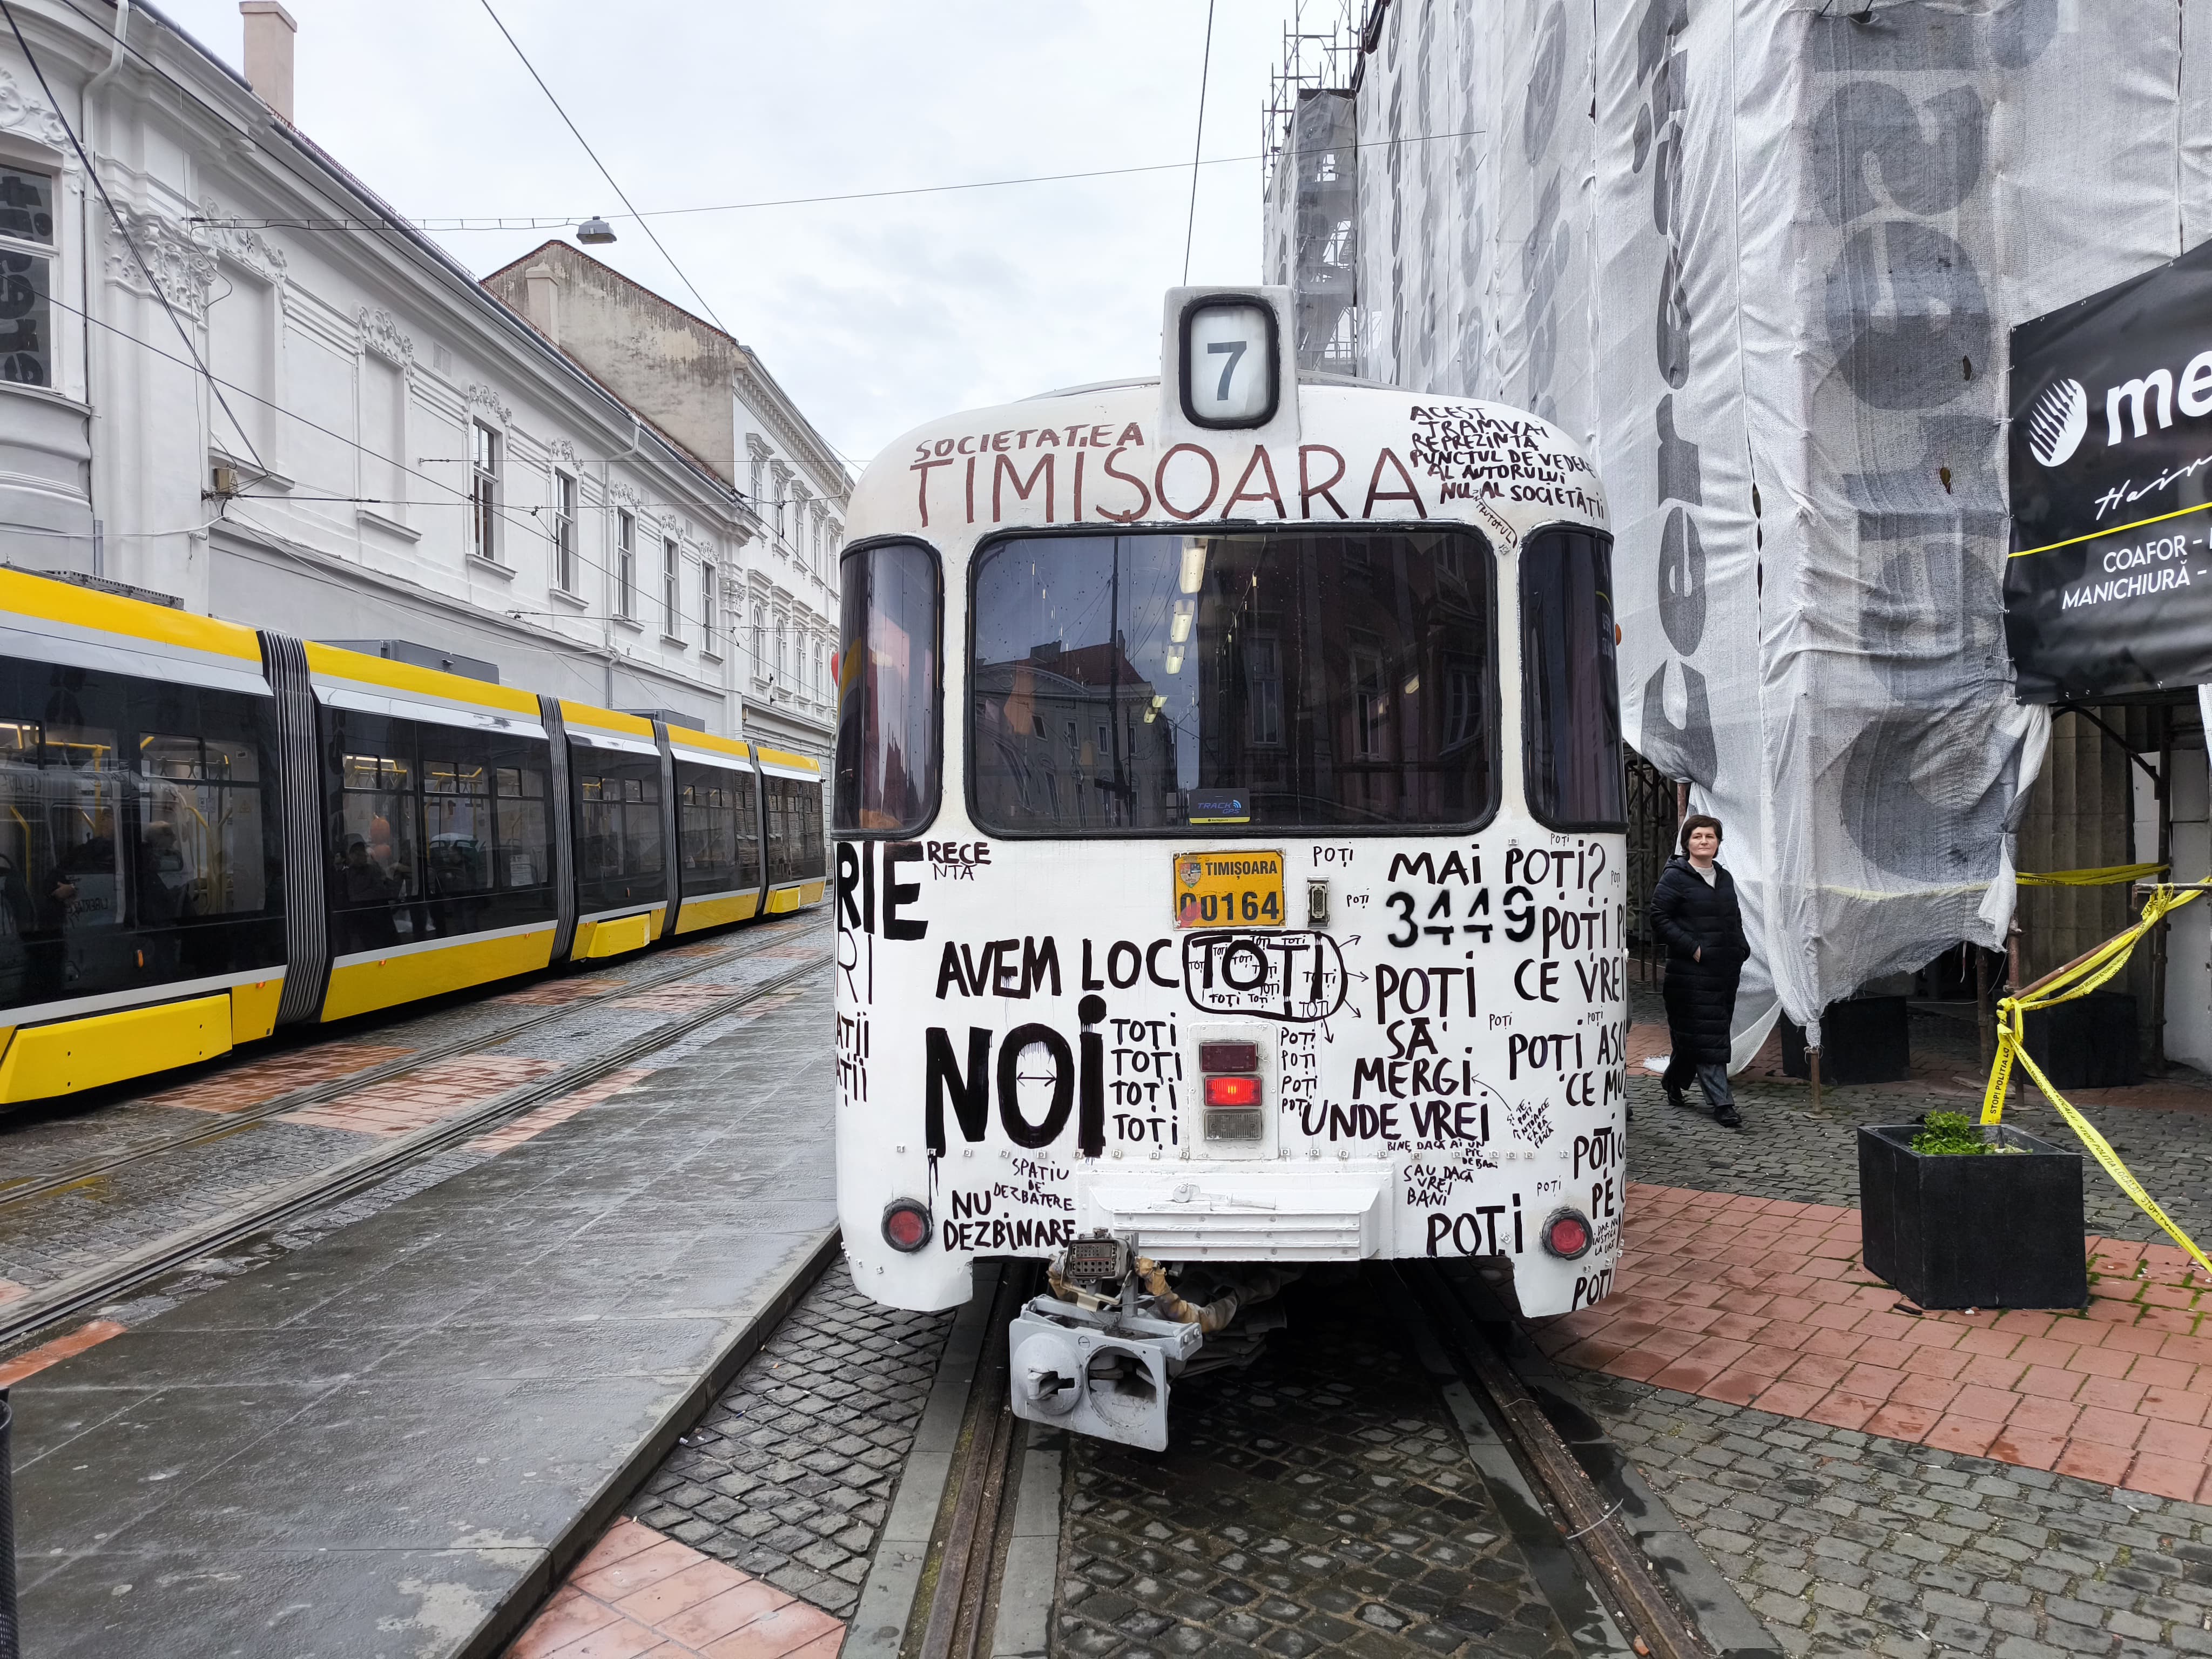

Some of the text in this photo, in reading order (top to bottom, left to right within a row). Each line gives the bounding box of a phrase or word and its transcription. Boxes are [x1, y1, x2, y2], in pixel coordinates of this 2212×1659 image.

[1207, 341, 1249, 402] 7
[1410, 406, 1486, 421] ACEST
[1427, 463, 1455, 481] AL
[1508, 449, 1534, 466] DE
[2103, 534, 2188, 574] COAFOR
[2062, 561, 2191, 610] MANICHIURĂ
[1205, 860, 1277, 879] TIMIȘOARA
[1179, 891, 1279, 921] 00164
[936, 935, 1062, 1000] AVEM
[1081, 938, 1181, 992] LOC
[1514, 959, 1560, 1003] CE
[1566, 1071, 1596, 1106] CE
[1988, 1091, 2001, 1115] STOP!
[1302, 1100, 1401, 1141] UNDE
[1404, 1164, 1436, 1182] SAU
[2075, 1122, 2096, 1145] STOP!
[2092, 1142, 2116, 1169] POLITIA
[2113, 1164, 2141, 1196] LOCALA!
[952, 1190, 992, 1220] NU
[1592, 1177, 1614, 1219] PE
